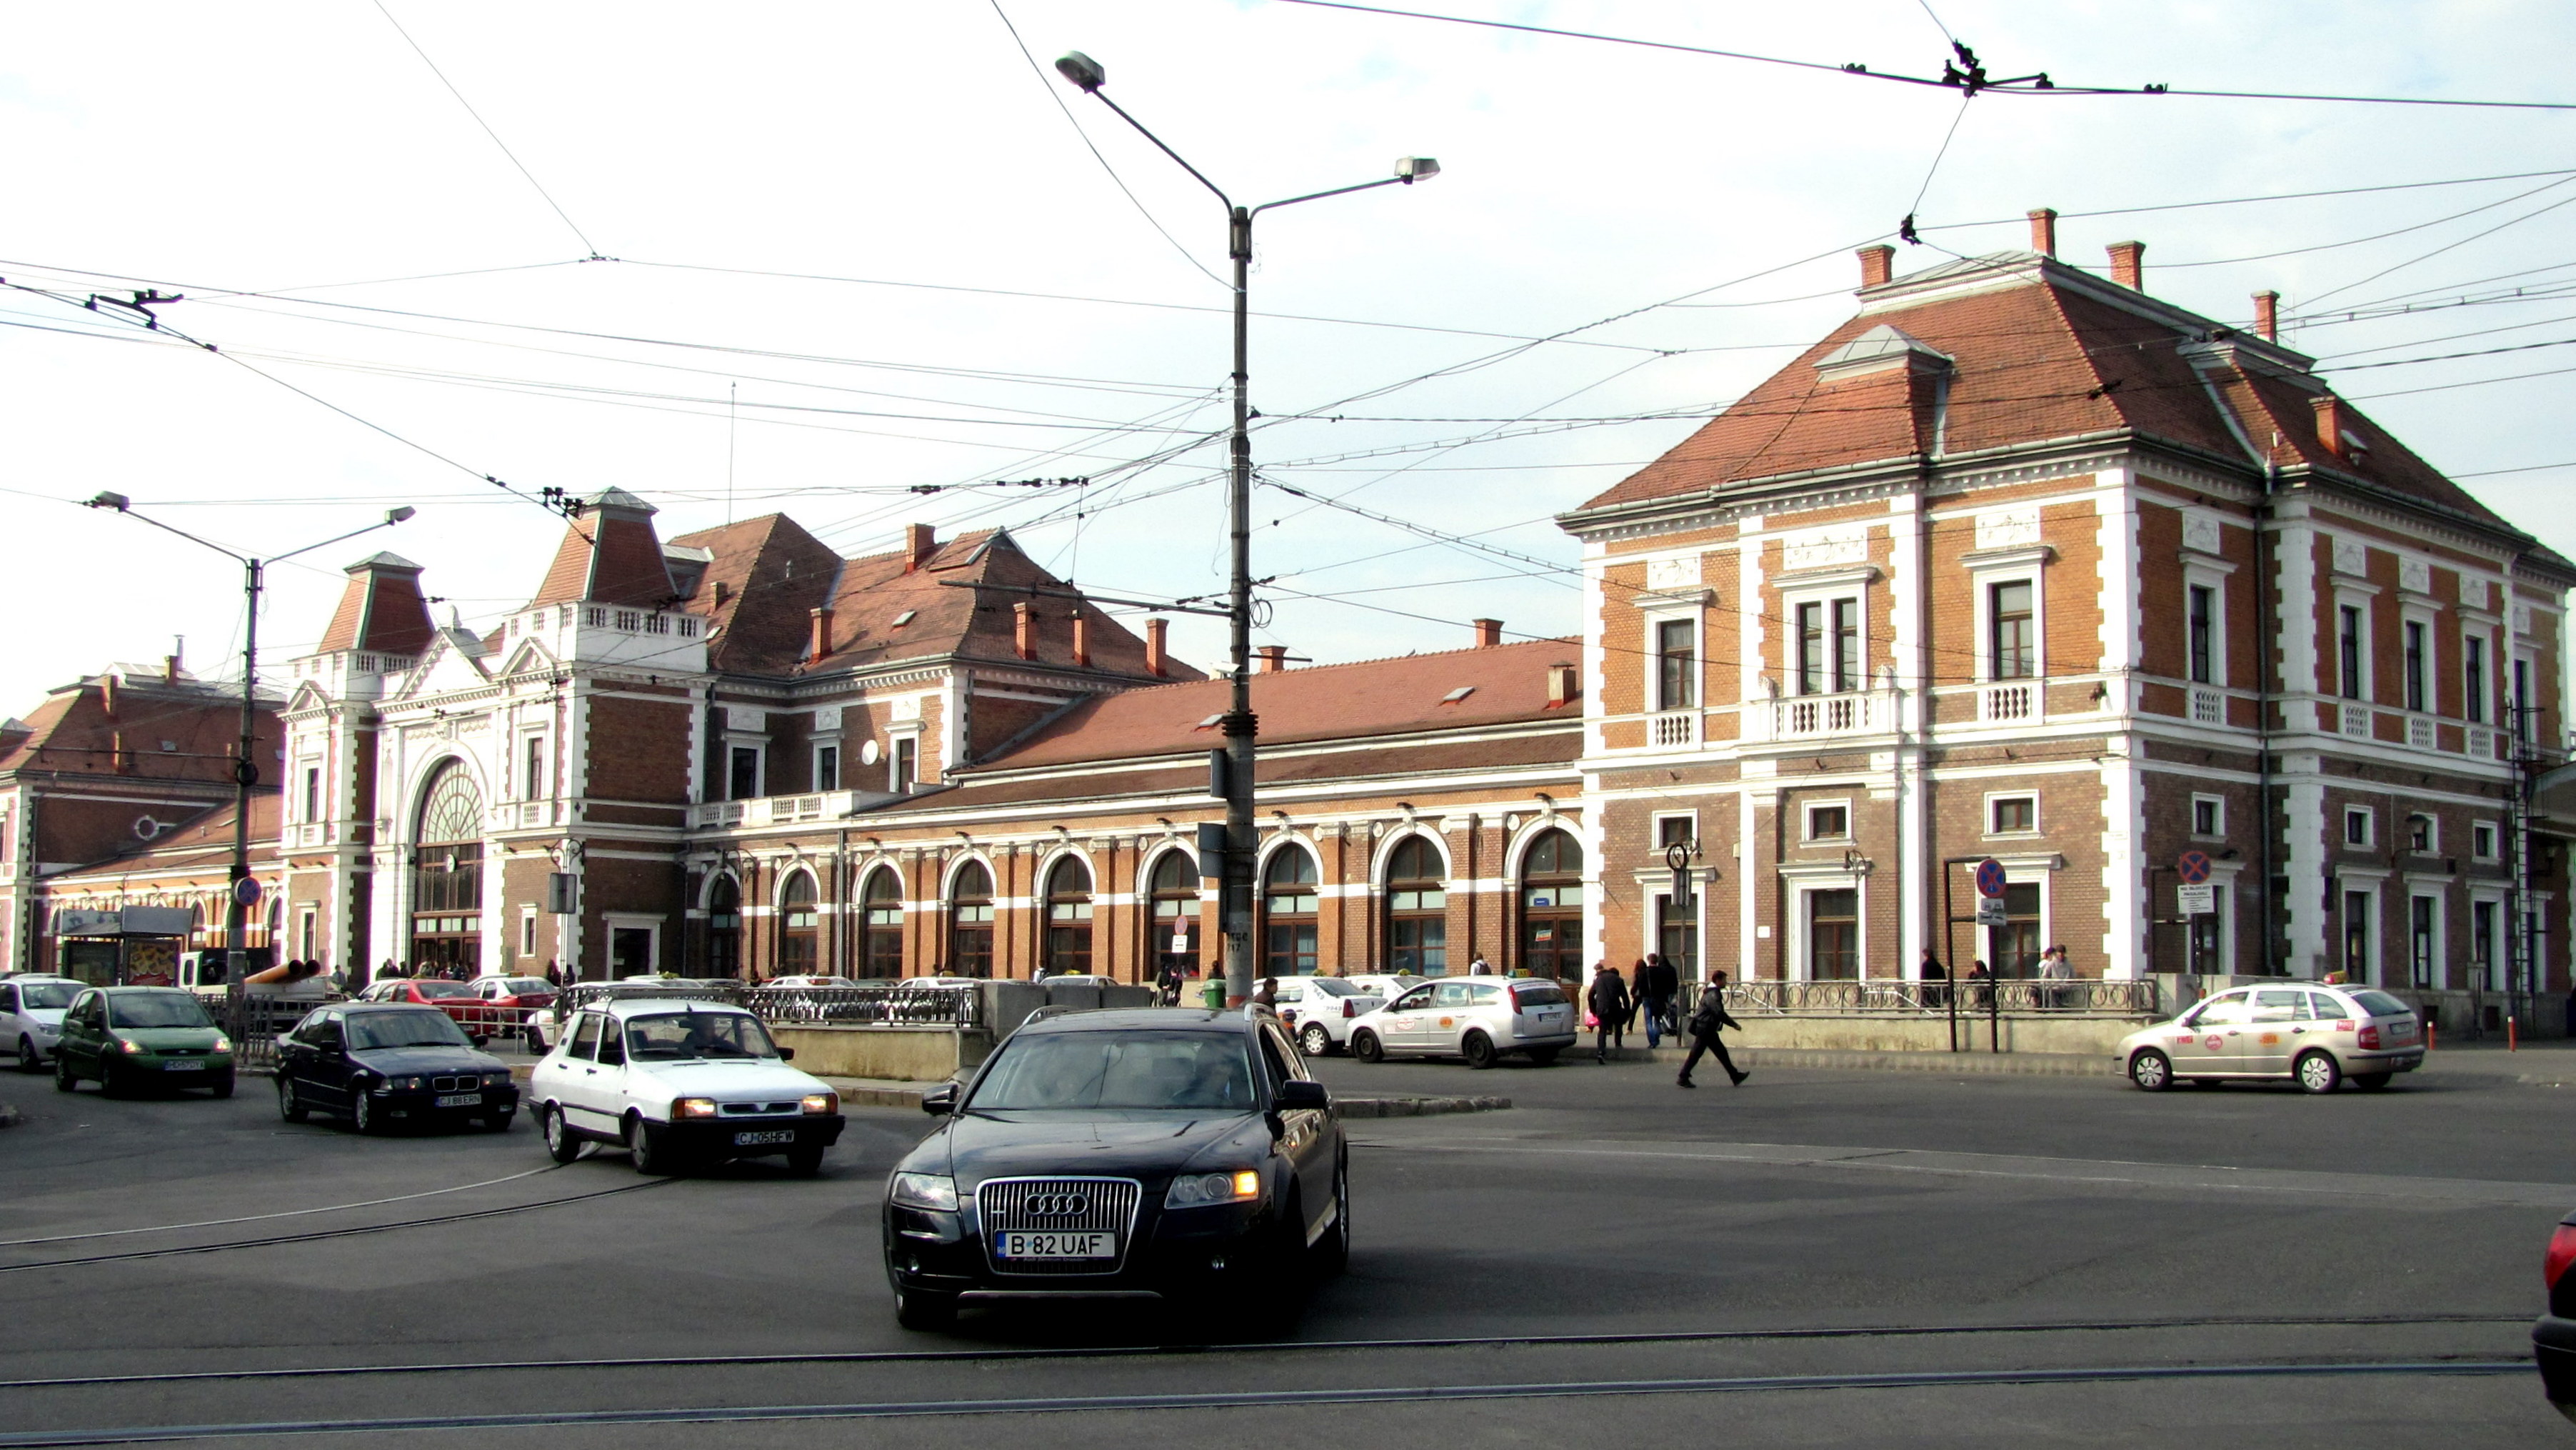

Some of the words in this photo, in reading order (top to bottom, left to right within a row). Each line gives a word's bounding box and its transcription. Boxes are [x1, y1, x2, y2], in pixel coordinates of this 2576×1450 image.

[1011, 1235, 1025, 1254] B
[1033, 1235, 1056, 1254] 82
[1061, 1234, 1103, 1254] UAF
